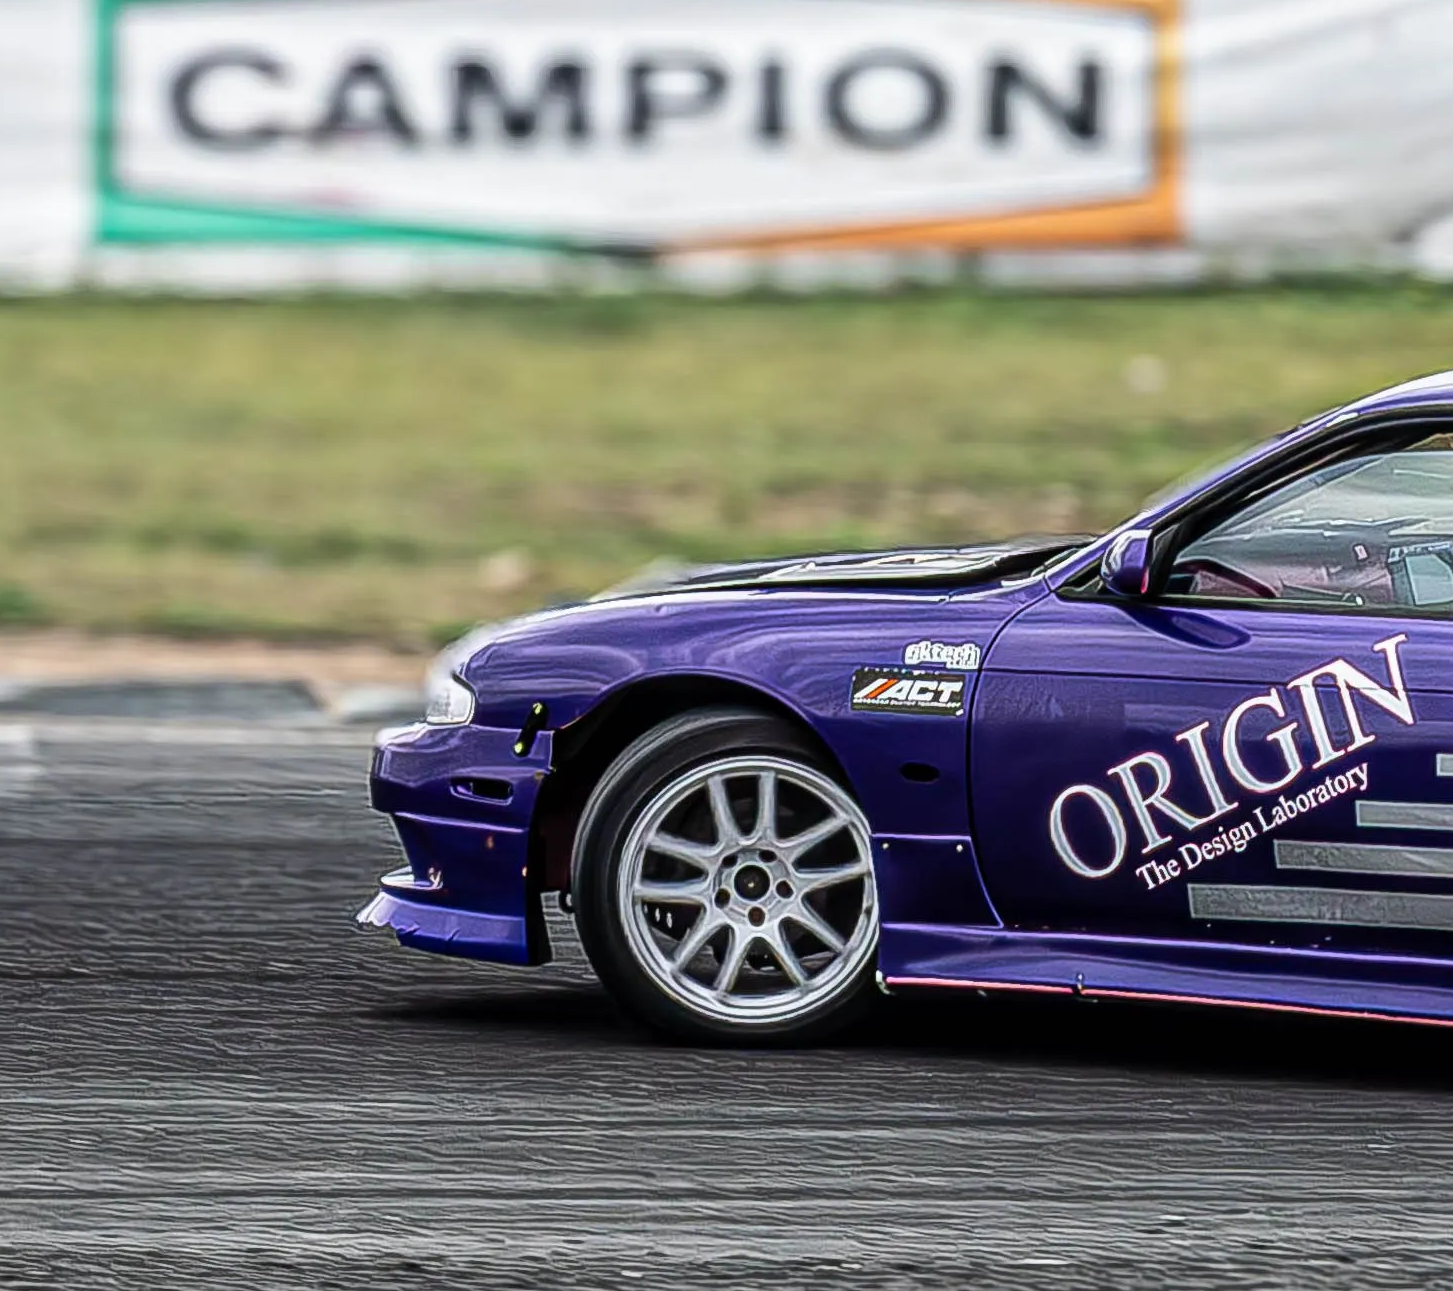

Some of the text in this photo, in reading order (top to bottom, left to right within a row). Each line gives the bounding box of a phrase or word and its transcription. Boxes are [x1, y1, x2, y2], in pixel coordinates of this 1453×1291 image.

[167, 45, 1104, 149] CAMPION
[1050, 633, 1416, 878] ORIGIN
[1136, 762, 1370, 890] The Design Laboratory
